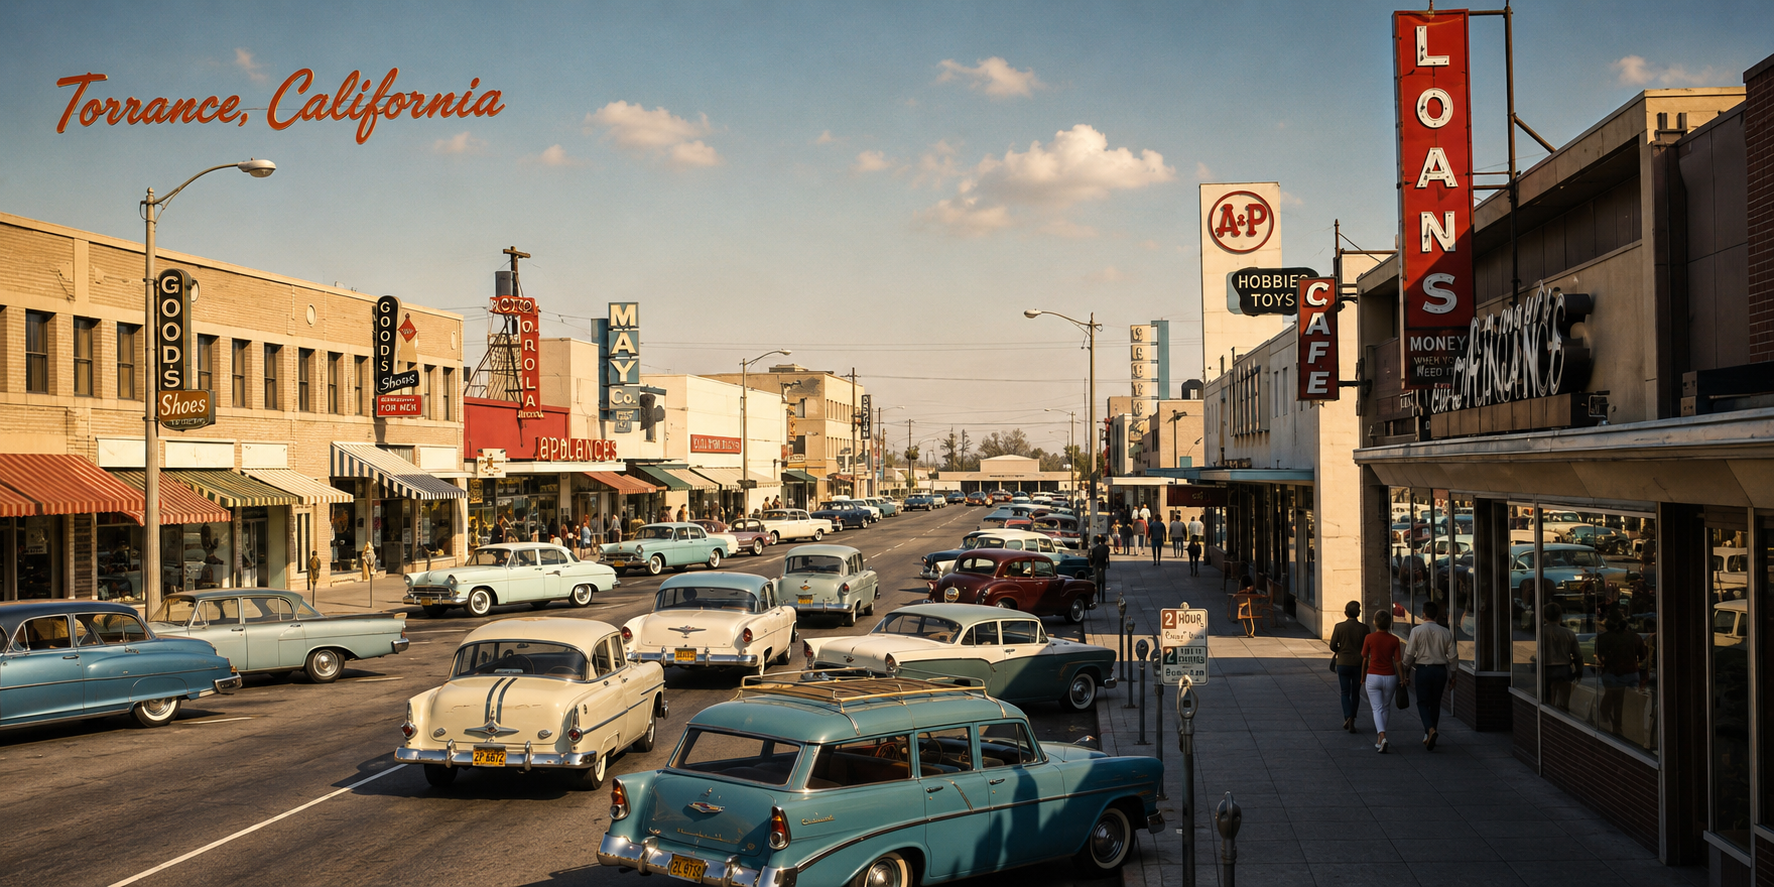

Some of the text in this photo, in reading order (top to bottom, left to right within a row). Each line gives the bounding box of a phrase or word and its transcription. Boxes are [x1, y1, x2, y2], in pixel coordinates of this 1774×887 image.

[1415, 25, 1458, 315] LOANS
[1216, 203, 1268, 237] A&P
[1238, 274, 1309, 289] HOBBIE
[1251, 293, 1295, 308] TOYS
[161, 275, 182, 388] GOOD'S
[380, 301, 391, 372] GOOD'S
[609, 303, 638, 382] MAY
[1304, 281, 1331, 394] CAFE
[1410, 335, 1467, 352] MONEY
[161, 393, 206, 416] Shoes
[611, 389, 636, 405] Co.
[1165, 612, 1173, 626] 2
[1166, 648, 1174, 663] 2
